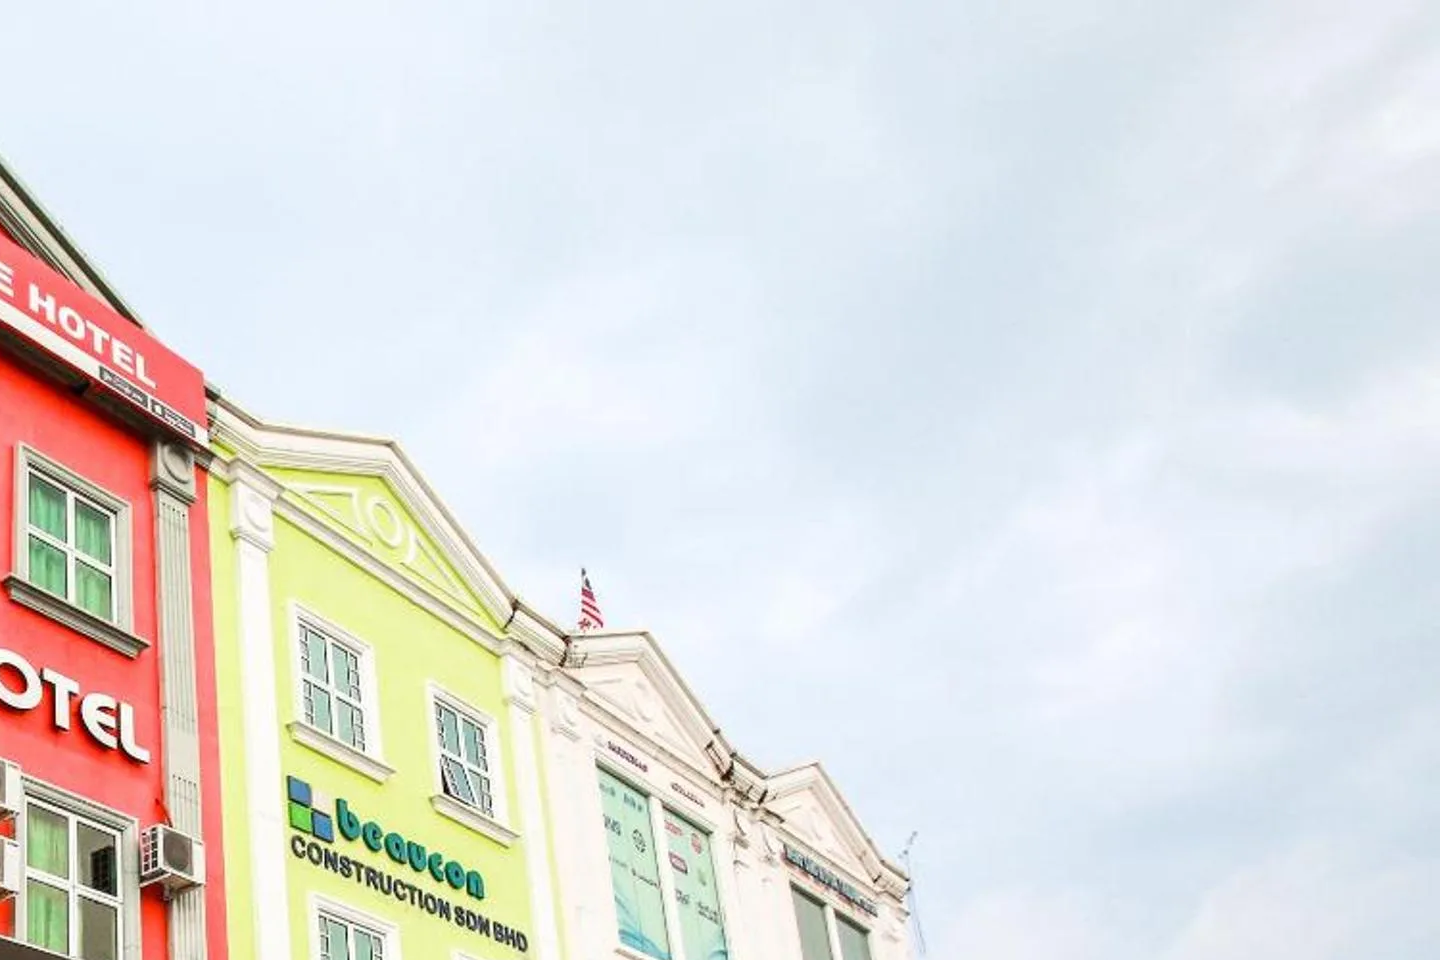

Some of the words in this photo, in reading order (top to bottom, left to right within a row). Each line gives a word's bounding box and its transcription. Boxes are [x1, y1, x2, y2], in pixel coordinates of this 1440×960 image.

[28, 282, 157, 389] HOTEL
[291, 835, 451, 922] CONSTRUCTION
[454, 905, 491, 938] SDN
[493, 922, 529, 953] BHD
